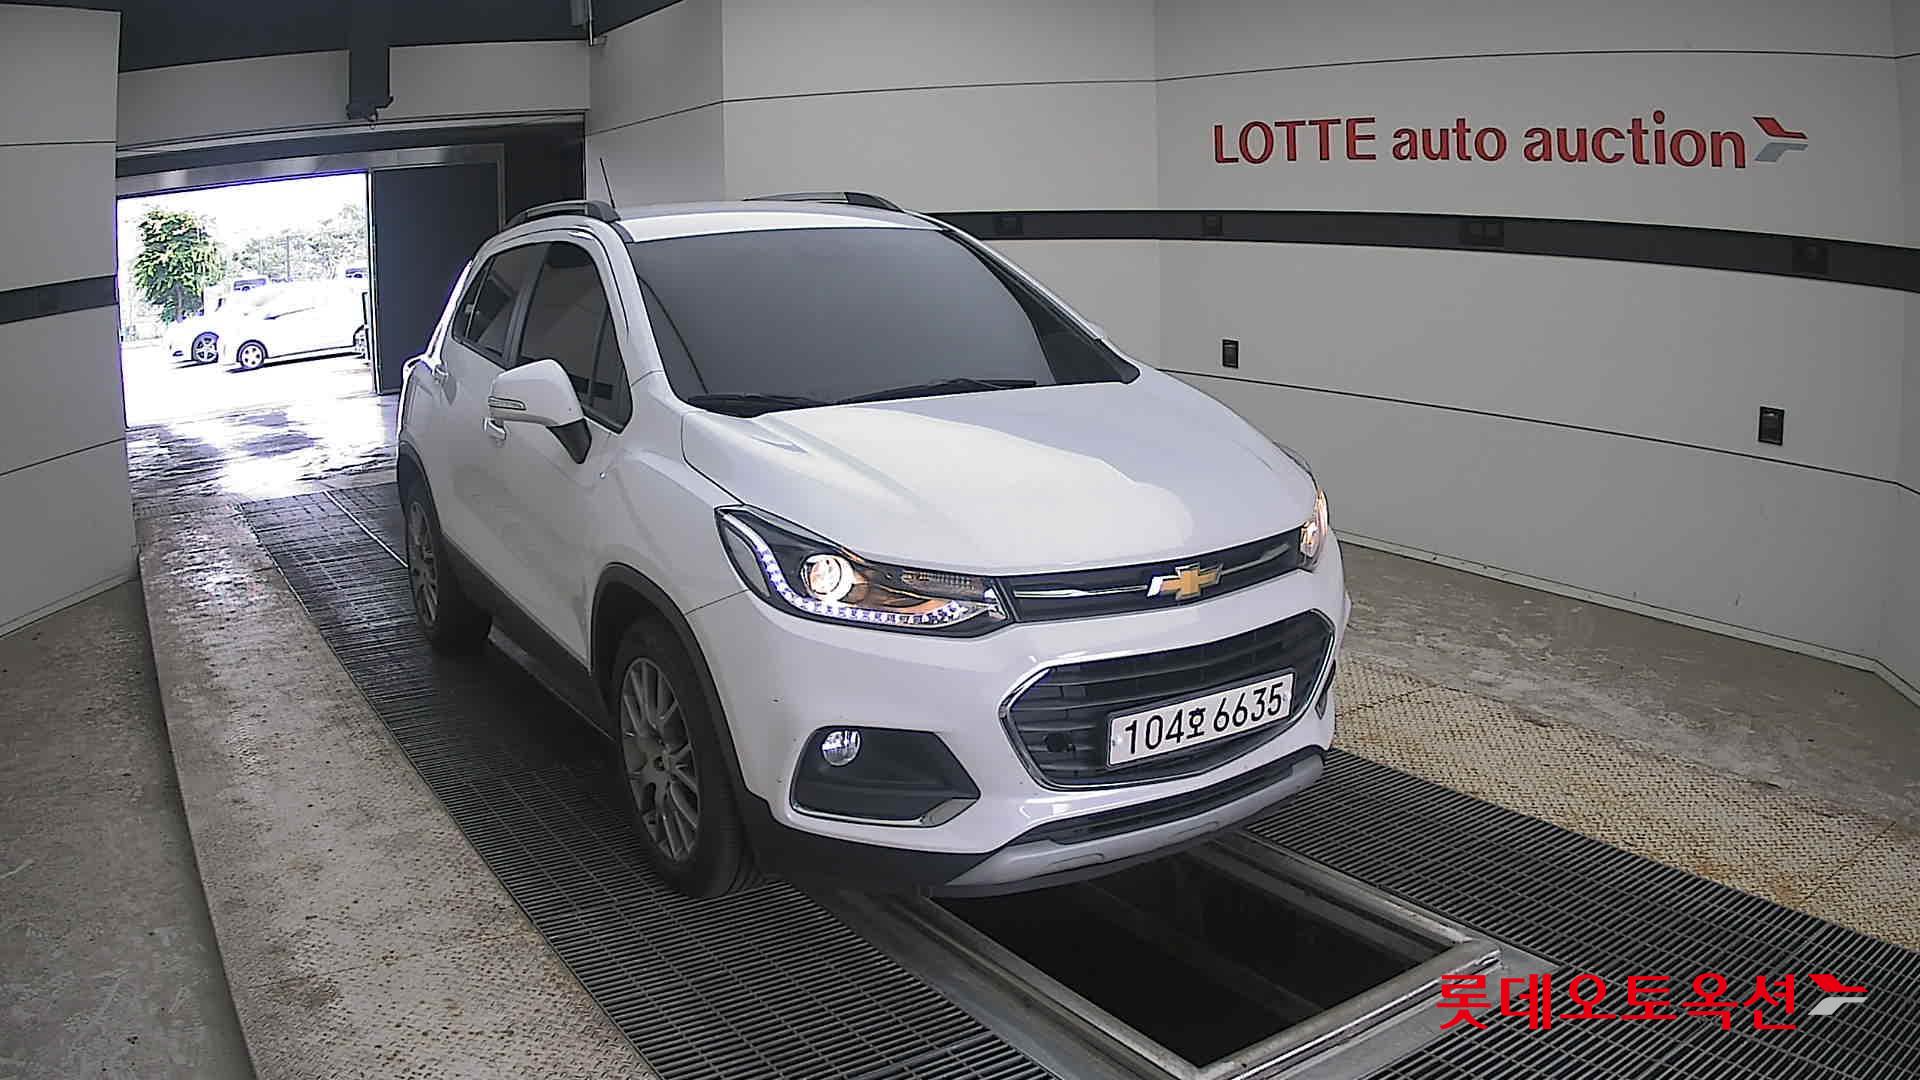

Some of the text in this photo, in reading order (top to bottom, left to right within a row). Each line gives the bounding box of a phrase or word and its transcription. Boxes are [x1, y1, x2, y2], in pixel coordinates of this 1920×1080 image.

[1213, 109, 1747, 169] LOTTE auto auction
[1124, 682, 1284, 755] 104호 6635
